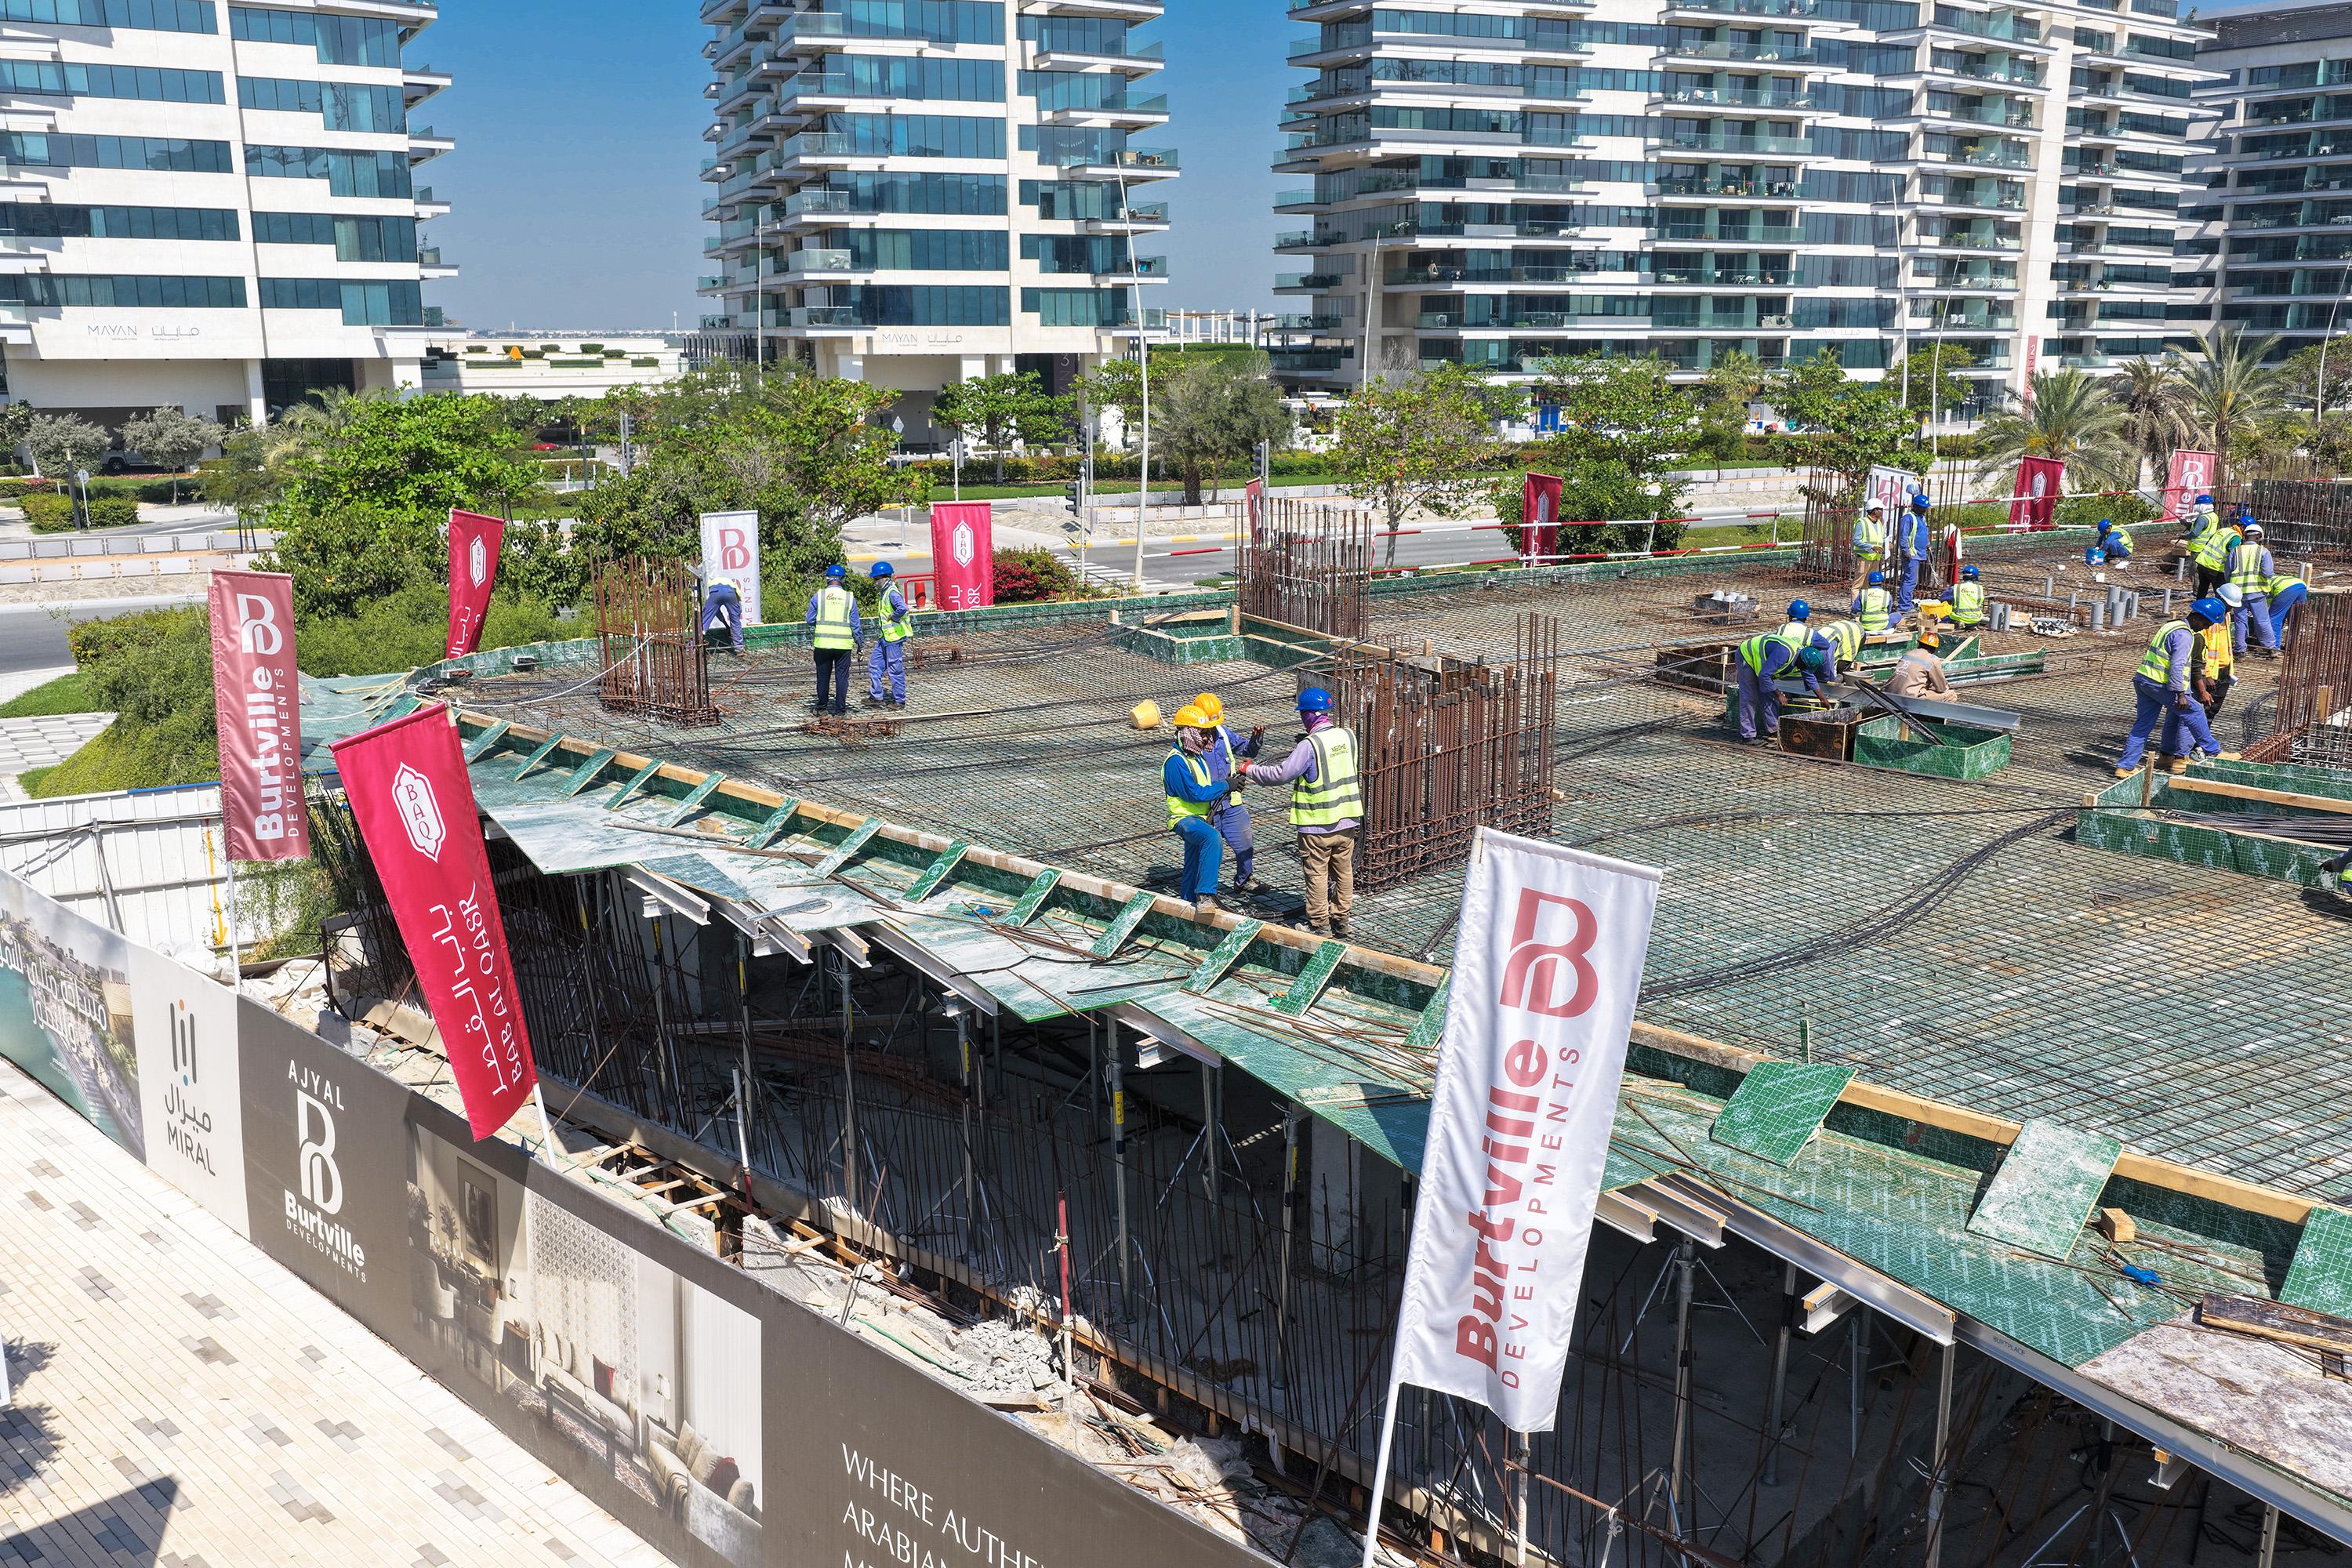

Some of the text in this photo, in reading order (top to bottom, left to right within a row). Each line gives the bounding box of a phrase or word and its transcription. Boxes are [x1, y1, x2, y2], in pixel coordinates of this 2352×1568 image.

[88, 325, 137, 336] MAYAN
[882, 332, 917, 343] MAYAN
[1061, 353, 1069, 366] 3
[2031, 344, 2035, 355] 2
[237, 593, 282, 654] B
[247, 666, 285, 840] Burtville
[274, 668, 299, 837] DEVELOPMENTS
[405, 783, 431, 840] BAQ
[459, 880, 523, 1087] BAB AL QASR
[1499, 887, 1600, 1018] B
[430, 903, 508, 1097] باب القصر
[165, 1083, 212, 1134] ميرال
[289, 1059, 345, 1111] AJYAL
[167, 1120, 216, 1177] MIRAL
[297, 1089, 343, 1214] B
[285, 1189, 365, 1267] Burtville
[1456, 1039, 1548, 1374] Burtville
[1501, 1047, 1580, 1390] DEVELOPMENTS
[286, 1219, 366, 1283] DEVELOPMENTS
[842, 1442, 1047, 1568] WHERE AUTH
[843, 1500, 949, 1568] ARABIA
